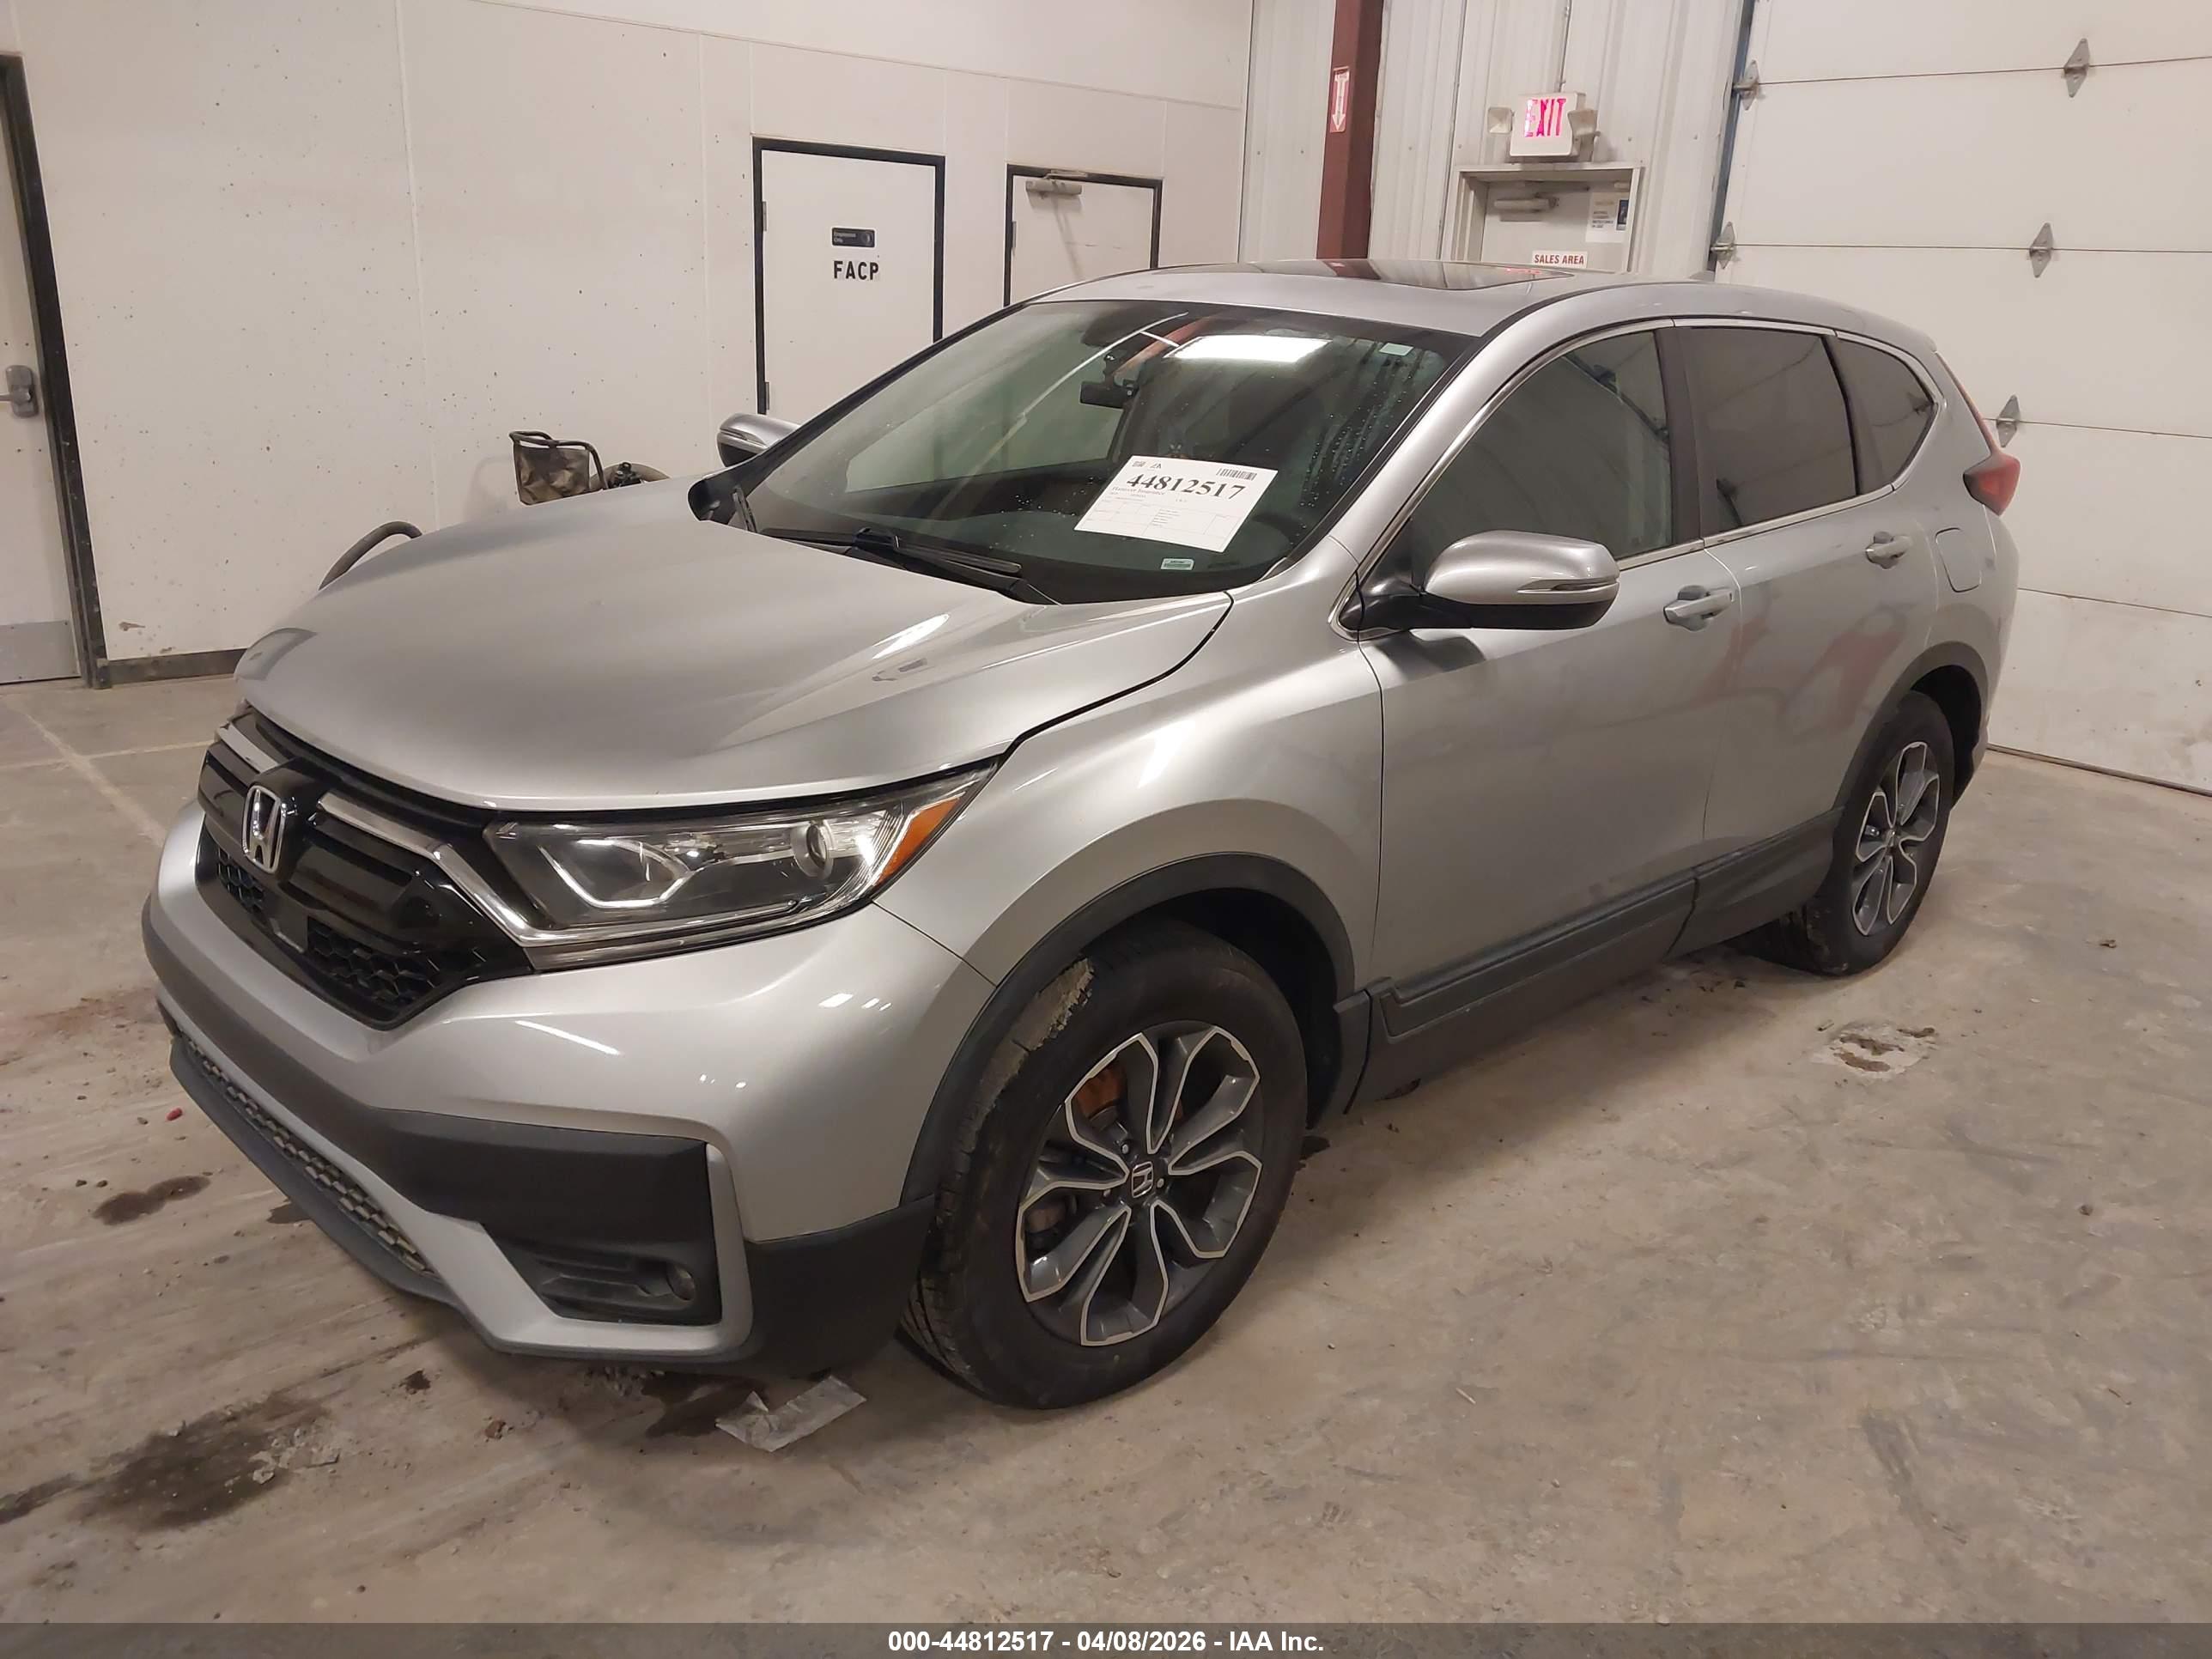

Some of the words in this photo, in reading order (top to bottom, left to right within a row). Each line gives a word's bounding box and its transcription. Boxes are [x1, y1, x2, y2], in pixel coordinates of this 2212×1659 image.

[1524, 98, 1567, 137] EXIT
[833, 260, 879, 281] FACP
[1534, 253, 1560, 264] SALES
[1561, 254, 1584, 265] AREA
[1126, 473, 1247, 500] 44812517
